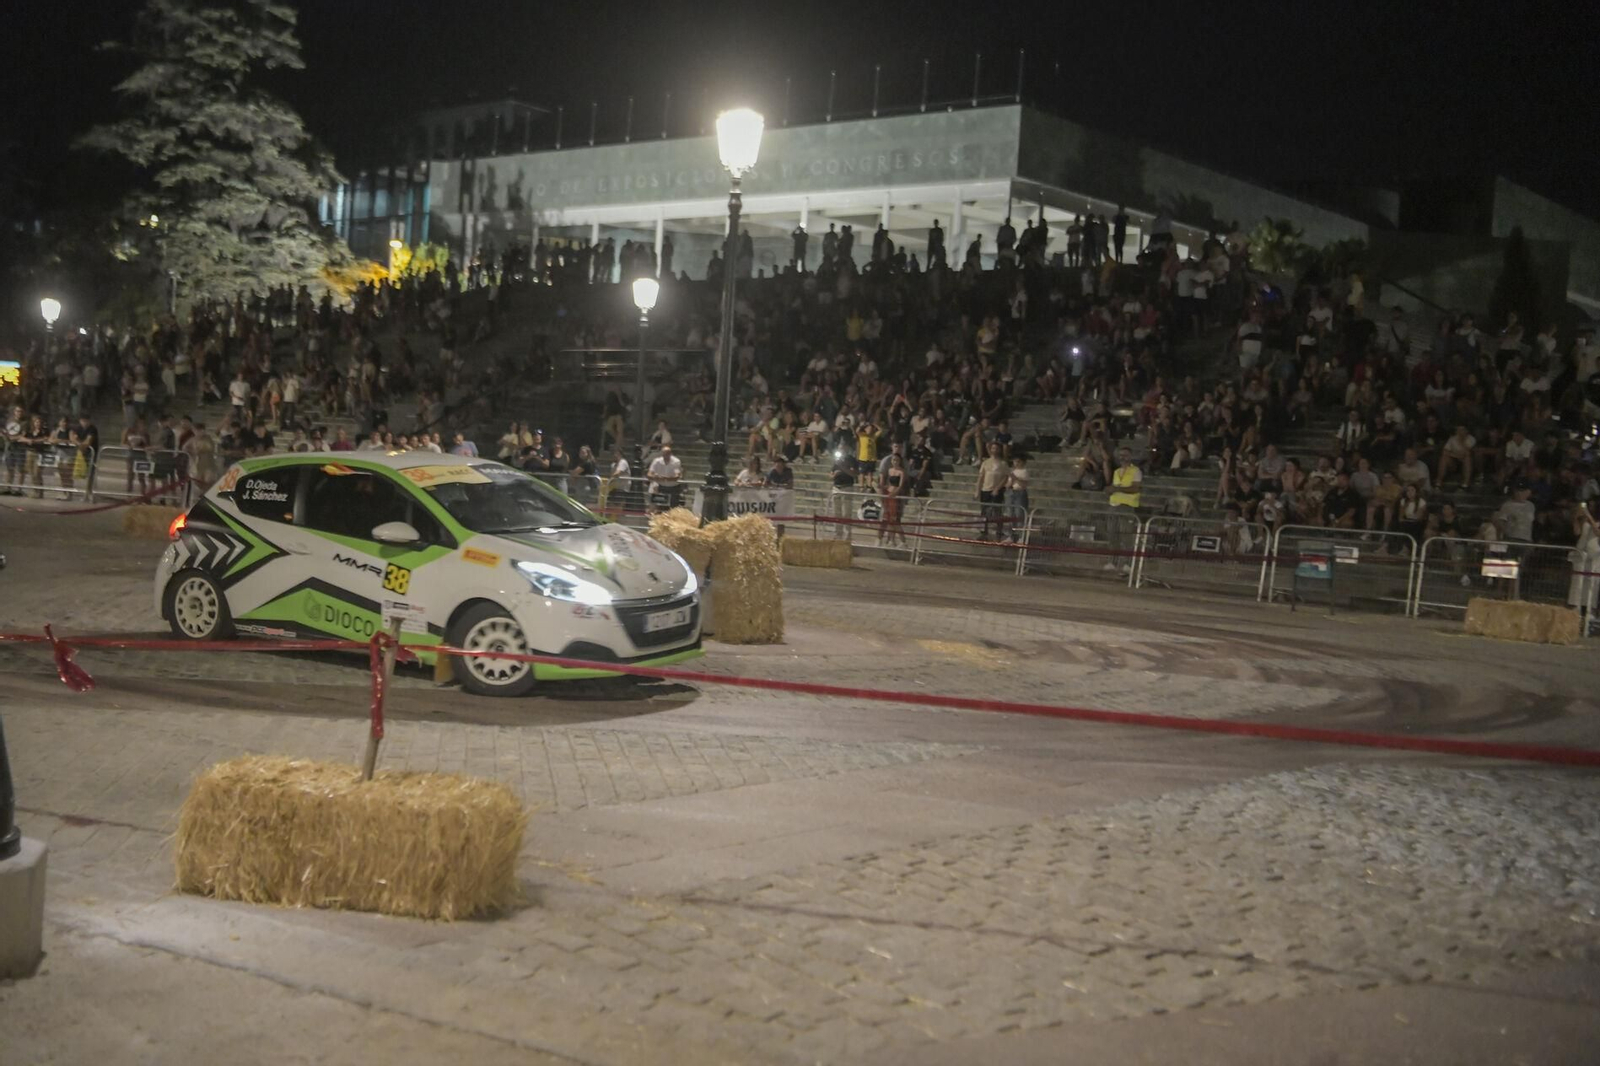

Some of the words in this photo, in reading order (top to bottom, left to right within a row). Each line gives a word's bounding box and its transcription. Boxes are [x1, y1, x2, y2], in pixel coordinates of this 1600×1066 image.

[245, 479, 278, 492] D.Ojeda
[332, 553, 383, 578] MMR
[384, 565, 409, 594] 38
[324, 605, 375, 637] DIOCO
